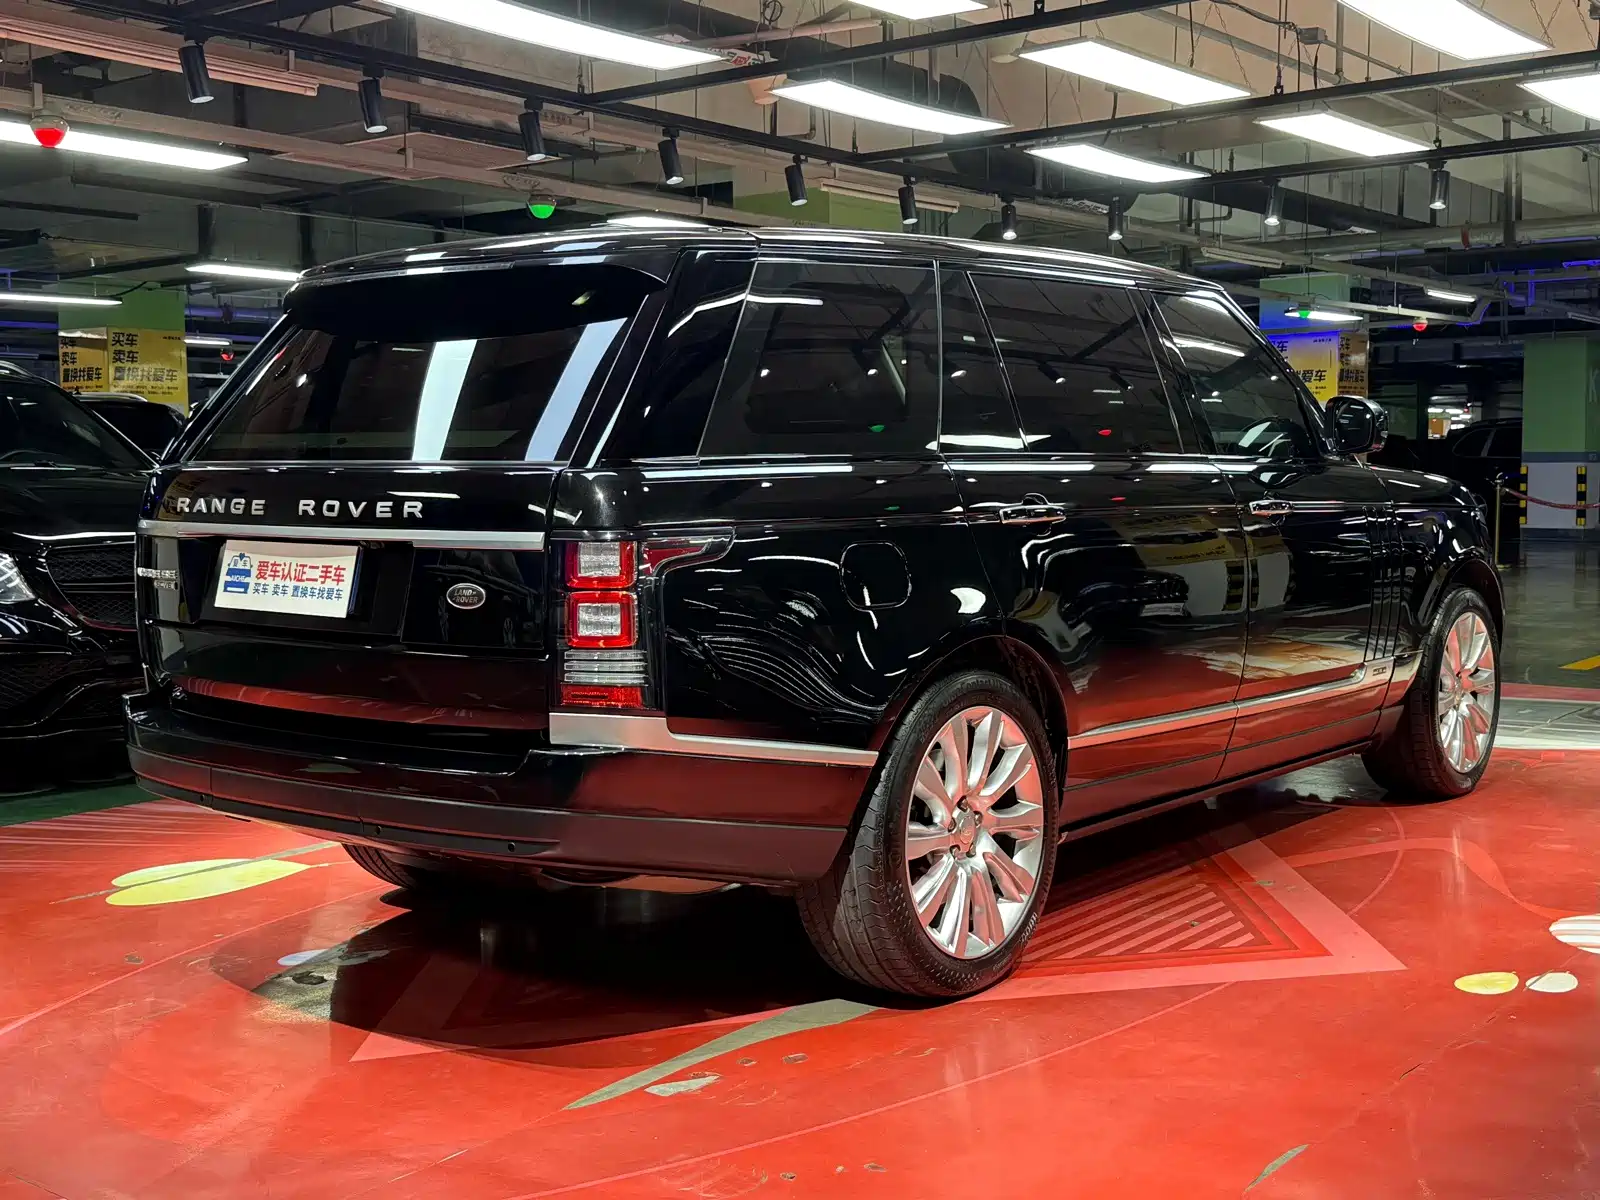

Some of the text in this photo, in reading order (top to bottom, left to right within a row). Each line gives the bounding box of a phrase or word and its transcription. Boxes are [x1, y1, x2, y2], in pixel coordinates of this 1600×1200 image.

[112, 332, 138, 347] 买车
[1272, 340, 1288, 353] 车
[61, 352, 77, 366] 卖车
[113, 350, 139, 364] 卖车
[114, 366, 178, 382] 置换找爱车
[176, 497, 266, 515] RANGE
[298, 499, 423, 519] ROVER
[255, 560, 347, 586] 爱车认证二手车
[252, 583, 344, 601] 买车 卖车 置换车找爱车
